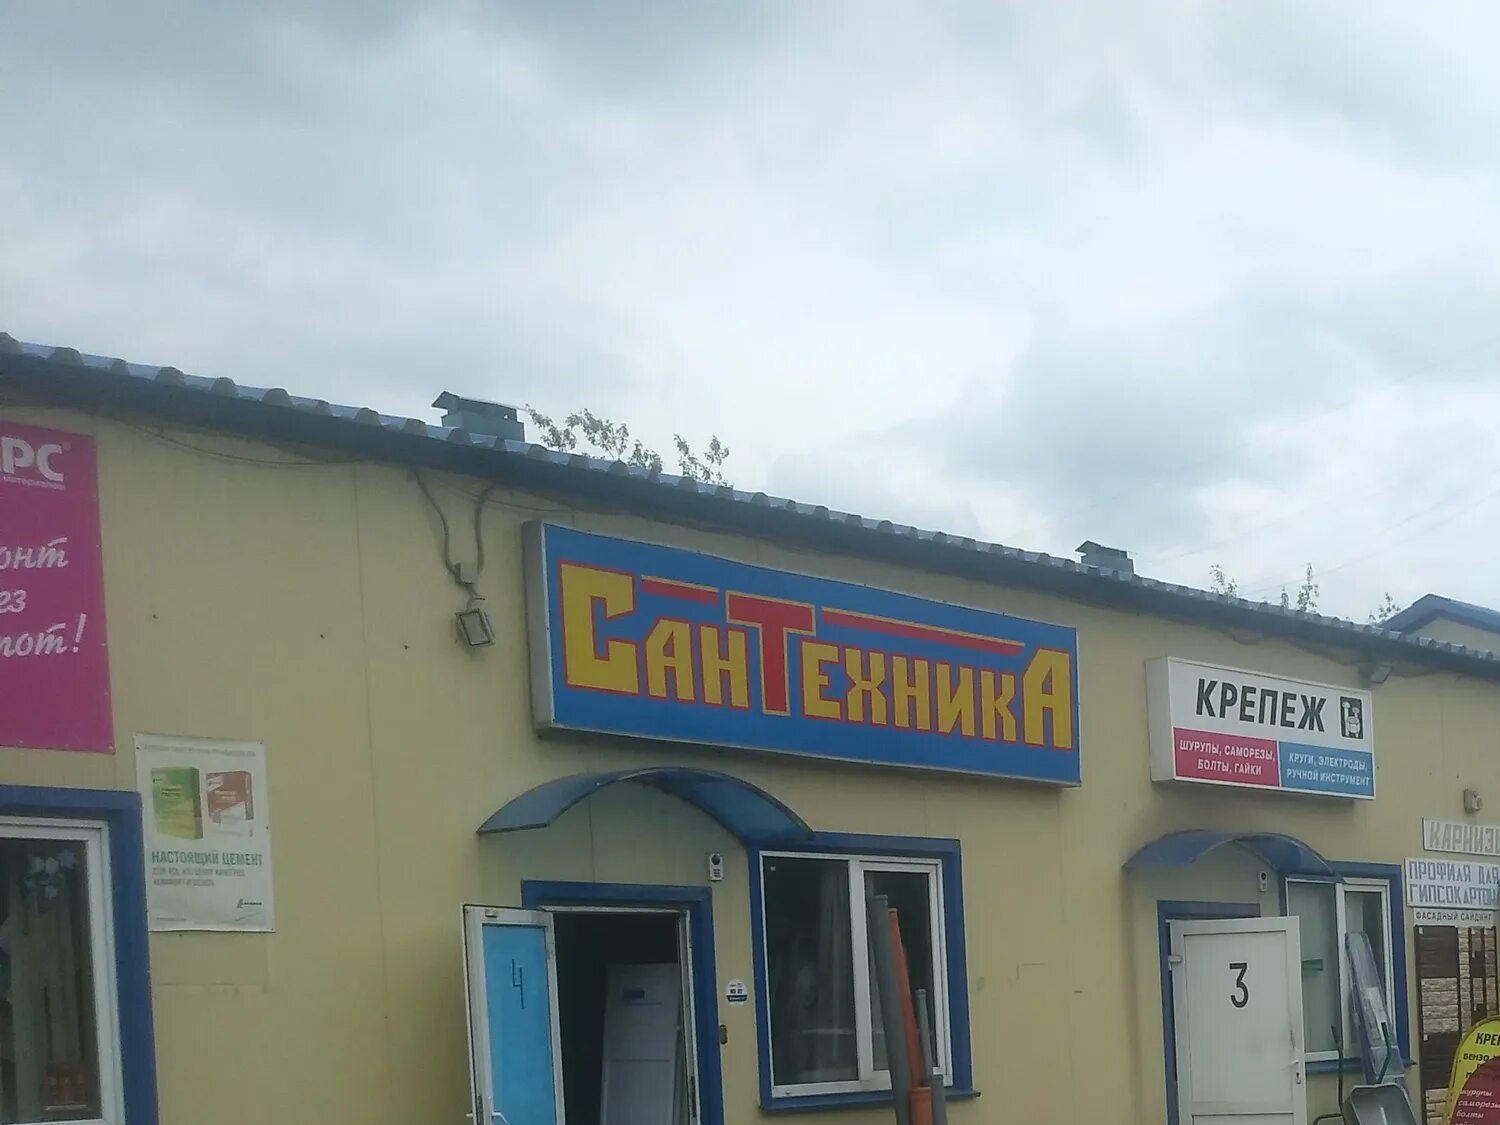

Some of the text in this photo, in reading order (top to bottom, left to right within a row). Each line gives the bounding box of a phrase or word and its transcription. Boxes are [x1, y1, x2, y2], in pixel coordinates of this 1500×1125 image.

[0, 436, 65, 483] РС
[558, 561, 1074, 750] САНТЕХНИКА
[1195, 678, 1327, 733] КРЕПЕЖ
[1179, 739, 1276, 762] ШУРУПЫ, САМОРЕЗЫ,
[1197, 758, 1262, 776] БОЛТЫ, ГАЙКИ
[1288, 752, 1368, 773] КРУГИ, ЭЛЕКТРОДЫ,
[1286, 768, 1370, 787] РУЧНОЙ ИНСТРУМЕНТ
[151, 850, 263, 867] НАСТОЯЩИЙ ЦЕМЕНТ
[1408, 861, 1499, 885] ПРОФИЛЯ ДЛЯ
[1415, 911, 1492, 922] ФАСАДНЫЙ САЙДИНГ
[511, 959, 525, 1010] 4
[1229, 962, 1249, 1009] 3
[1460, 1089, 1492, 1097] шурупы
[1456, 1110, 1484, 1118] болты
[1458, 1100, 1500, 1109] саморезы
